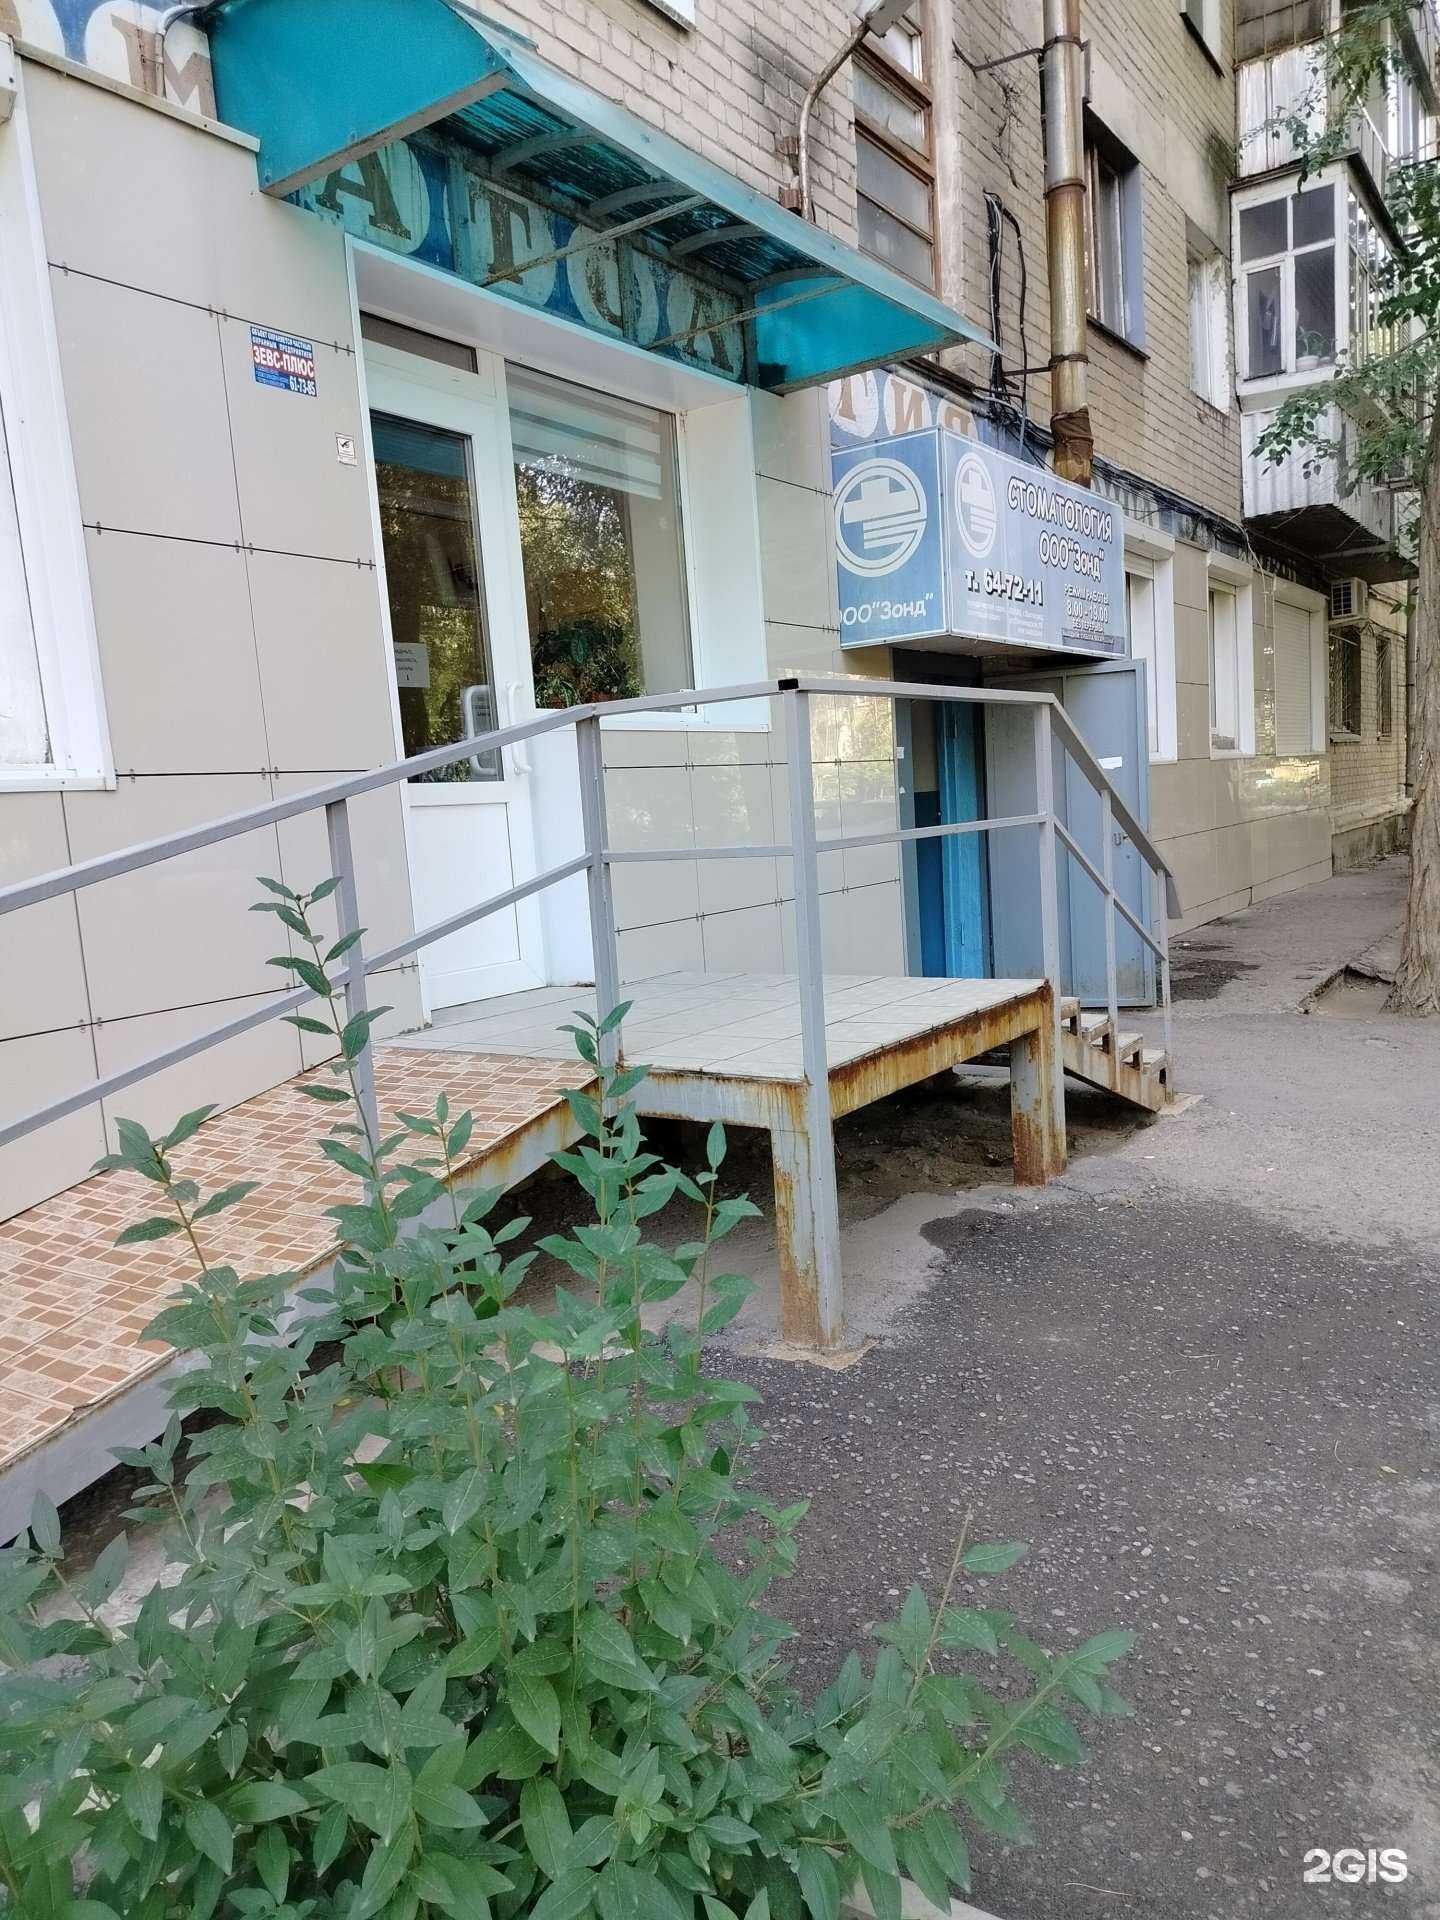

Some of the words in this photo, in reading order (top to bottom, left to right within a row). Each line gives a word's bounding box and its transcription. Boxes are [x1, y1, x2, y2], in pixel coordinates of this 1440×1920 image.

[253, 346, 314, 378] ЗЕВС-ПЛЮС
[1007, 475, 1113, 544] СТОМАТОЛОГИЯ
[983, 567, 1045, 606] 64-72-11
